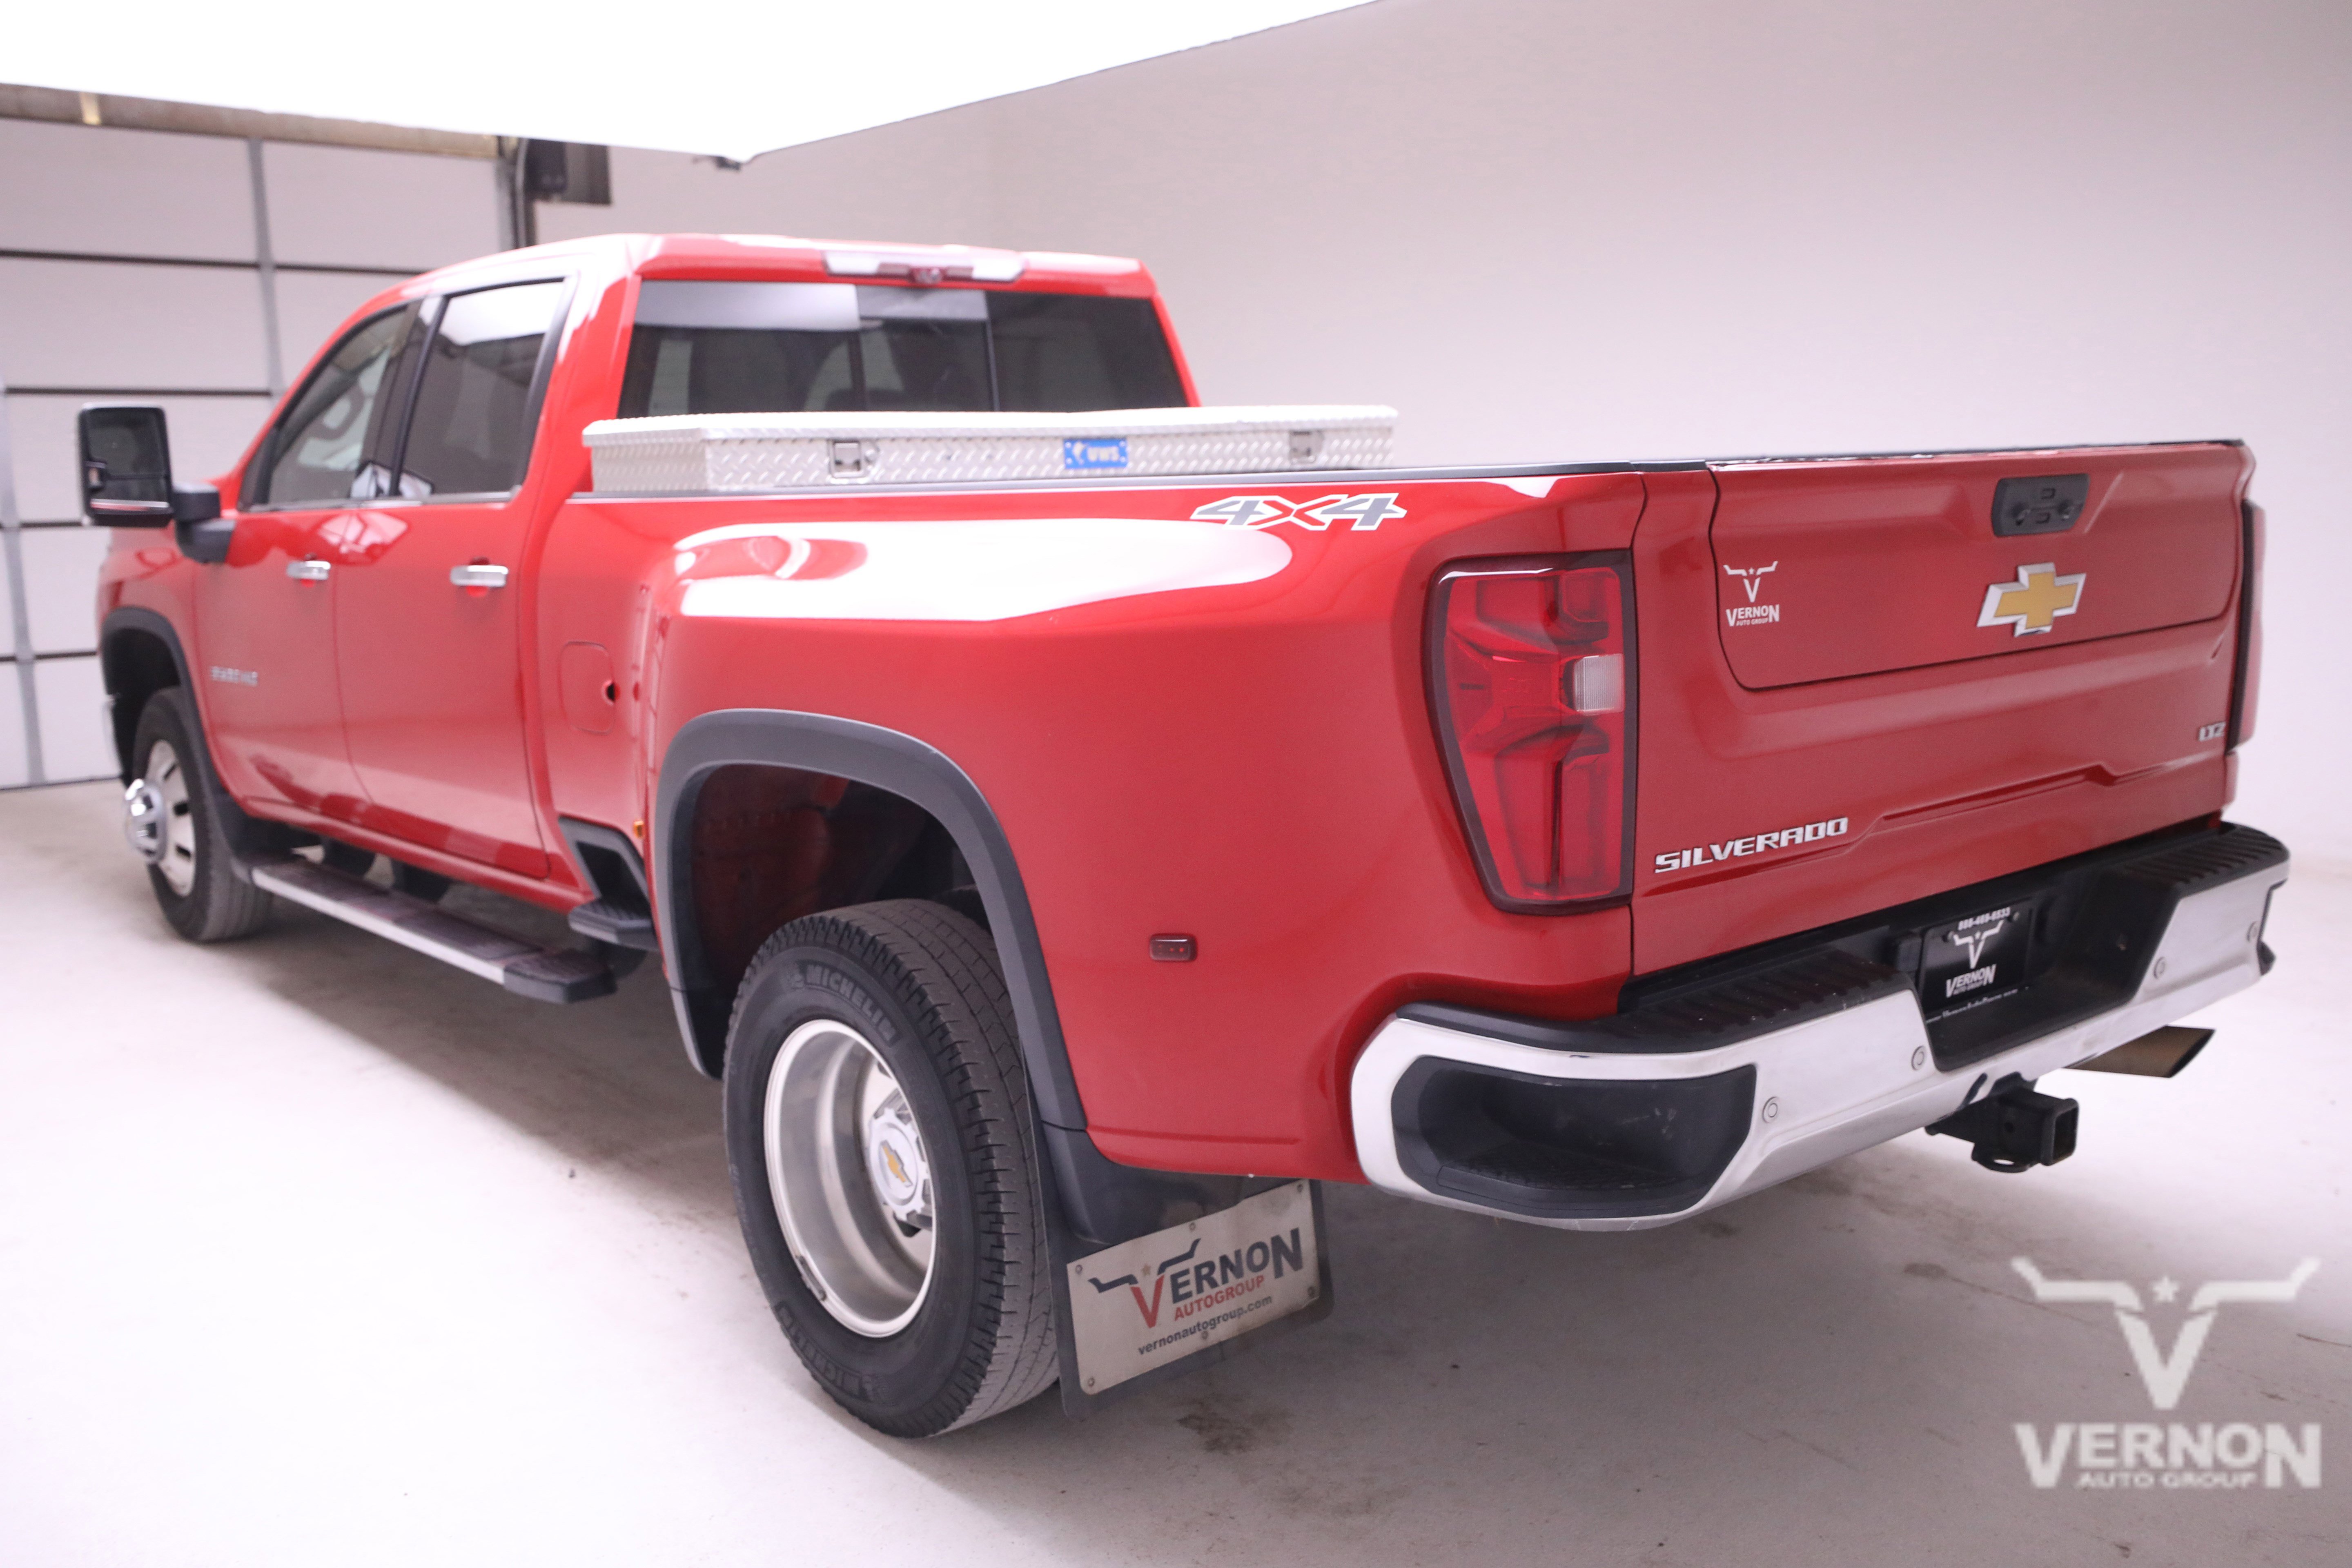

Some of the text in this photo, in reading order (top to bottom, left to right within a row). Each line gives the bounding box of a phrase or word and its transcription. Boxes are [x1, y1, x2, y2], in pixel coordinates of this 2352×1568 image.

[1726, 604, 1780, 627] VERNON
[1655, 817, 1849, 873] SILVERADO
[806, 963, 897, 1041] MICHELIN
[1946, 964, 1996, 998] VERNON
[1130, 1227, 1303, 1328] VERNON
[1174, 1275, 1265, 1322] AUTOGROUP
[1138, 1295, 1272, 1355] vernonautogroup.com
